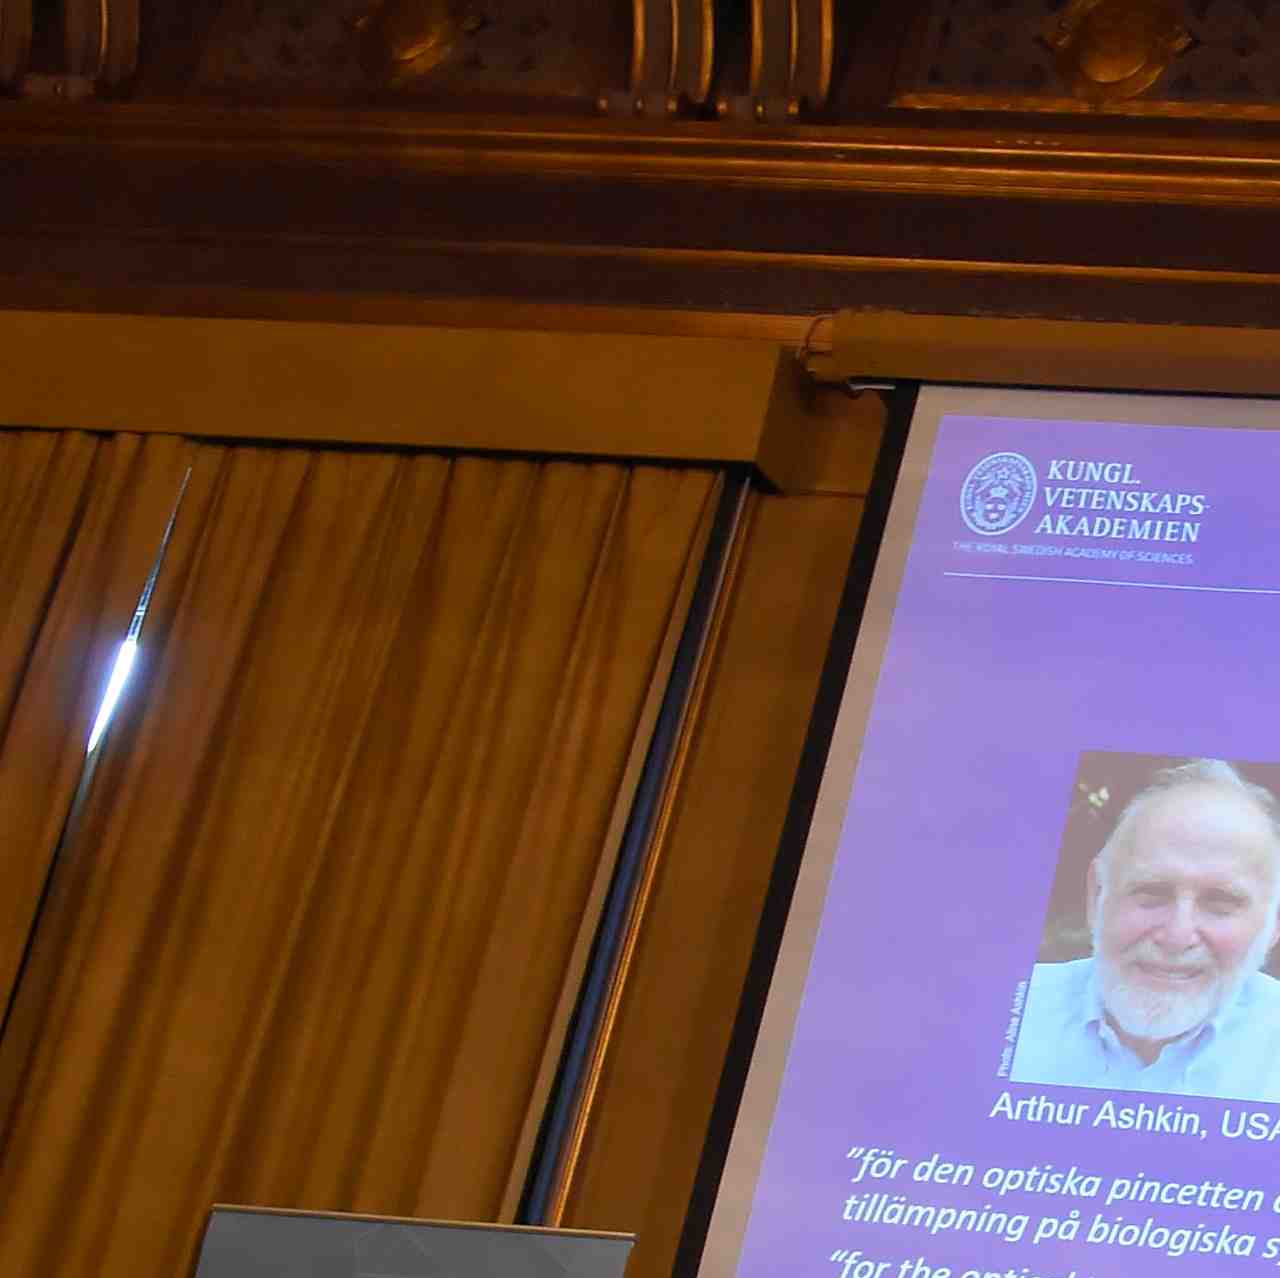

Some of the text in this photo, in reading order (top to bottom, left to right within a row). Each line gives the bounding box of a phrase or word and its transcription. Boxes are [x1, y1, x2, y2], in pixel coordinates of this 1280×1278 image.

[1047, 459, 1141, 485] KUNGL.
[1034, 513, 1201, 543] AKADEMIEN
[988, 1091, 1091, 1125] Arthur
[1092, 1100, 1208, 1141] Ashkin,
[845, 1146, 909, 1183] ”för
[912, 1153, 974, 1186] den
[982, 1164, 1102, 1197] optiska
[1105, 1172, 1265, 1212] pincetten
[842, 1193, 1030, 1242] tillämpning
[1032, 1210, 1081, 1245] på
[1085, 1213, 1257, 1257] biologiska
